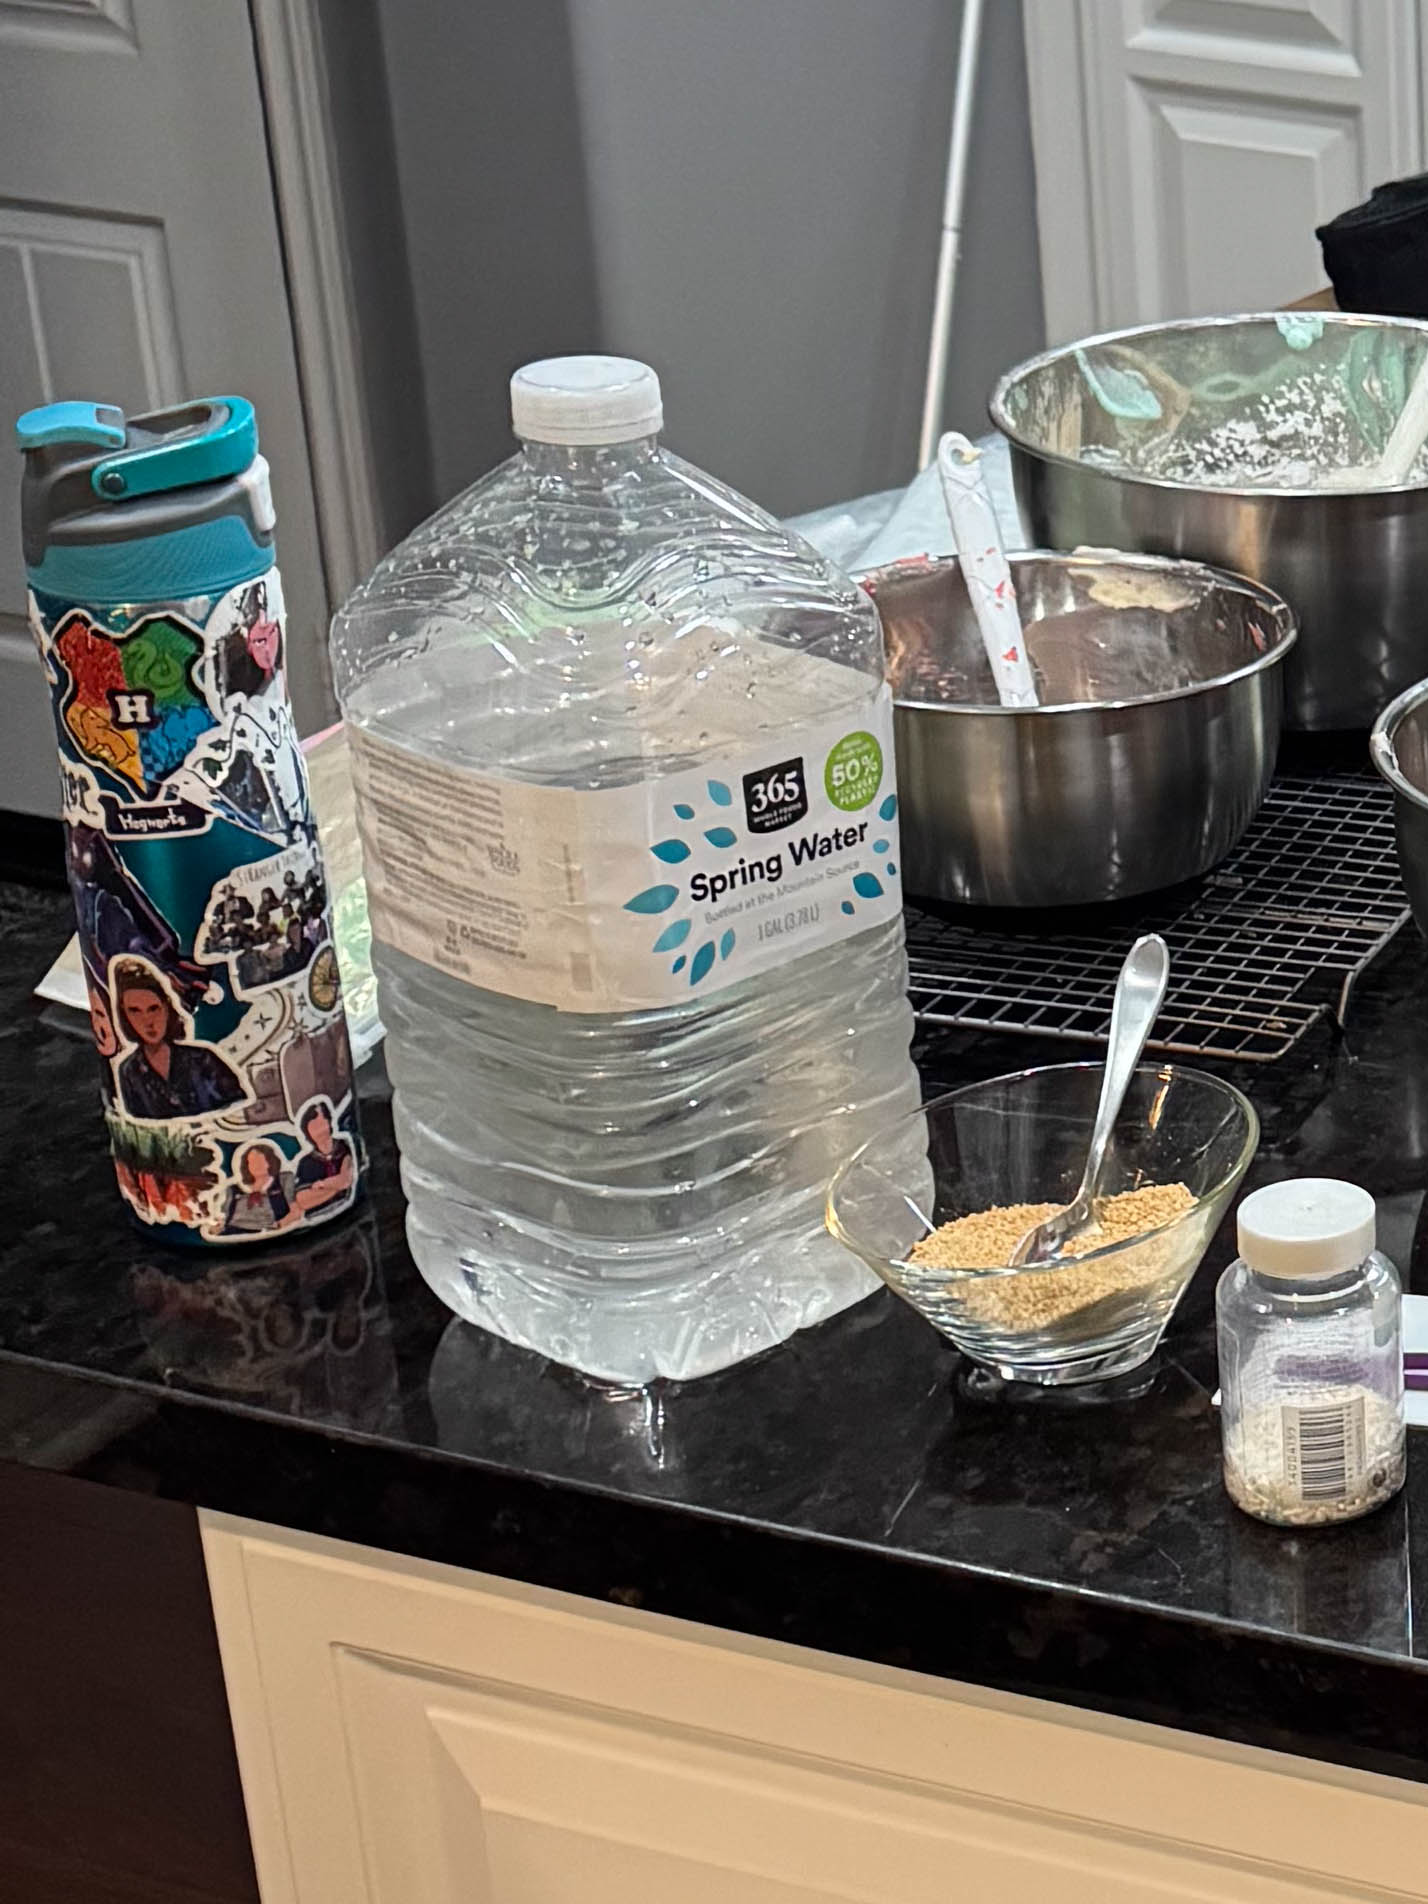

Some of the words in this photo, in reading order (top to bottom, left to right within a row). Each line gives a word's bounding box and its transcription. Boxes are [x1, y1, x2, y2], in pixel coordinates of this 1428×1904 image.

[114, 694, 151, 723] H
[831, 752, 878, 787] 50%
[751, 770, 799, 812] 365
[118, 807, 187, 833] Hogwarts
[690, 853, 783, 903] Spring
[787, 821, 869, 867] Water
